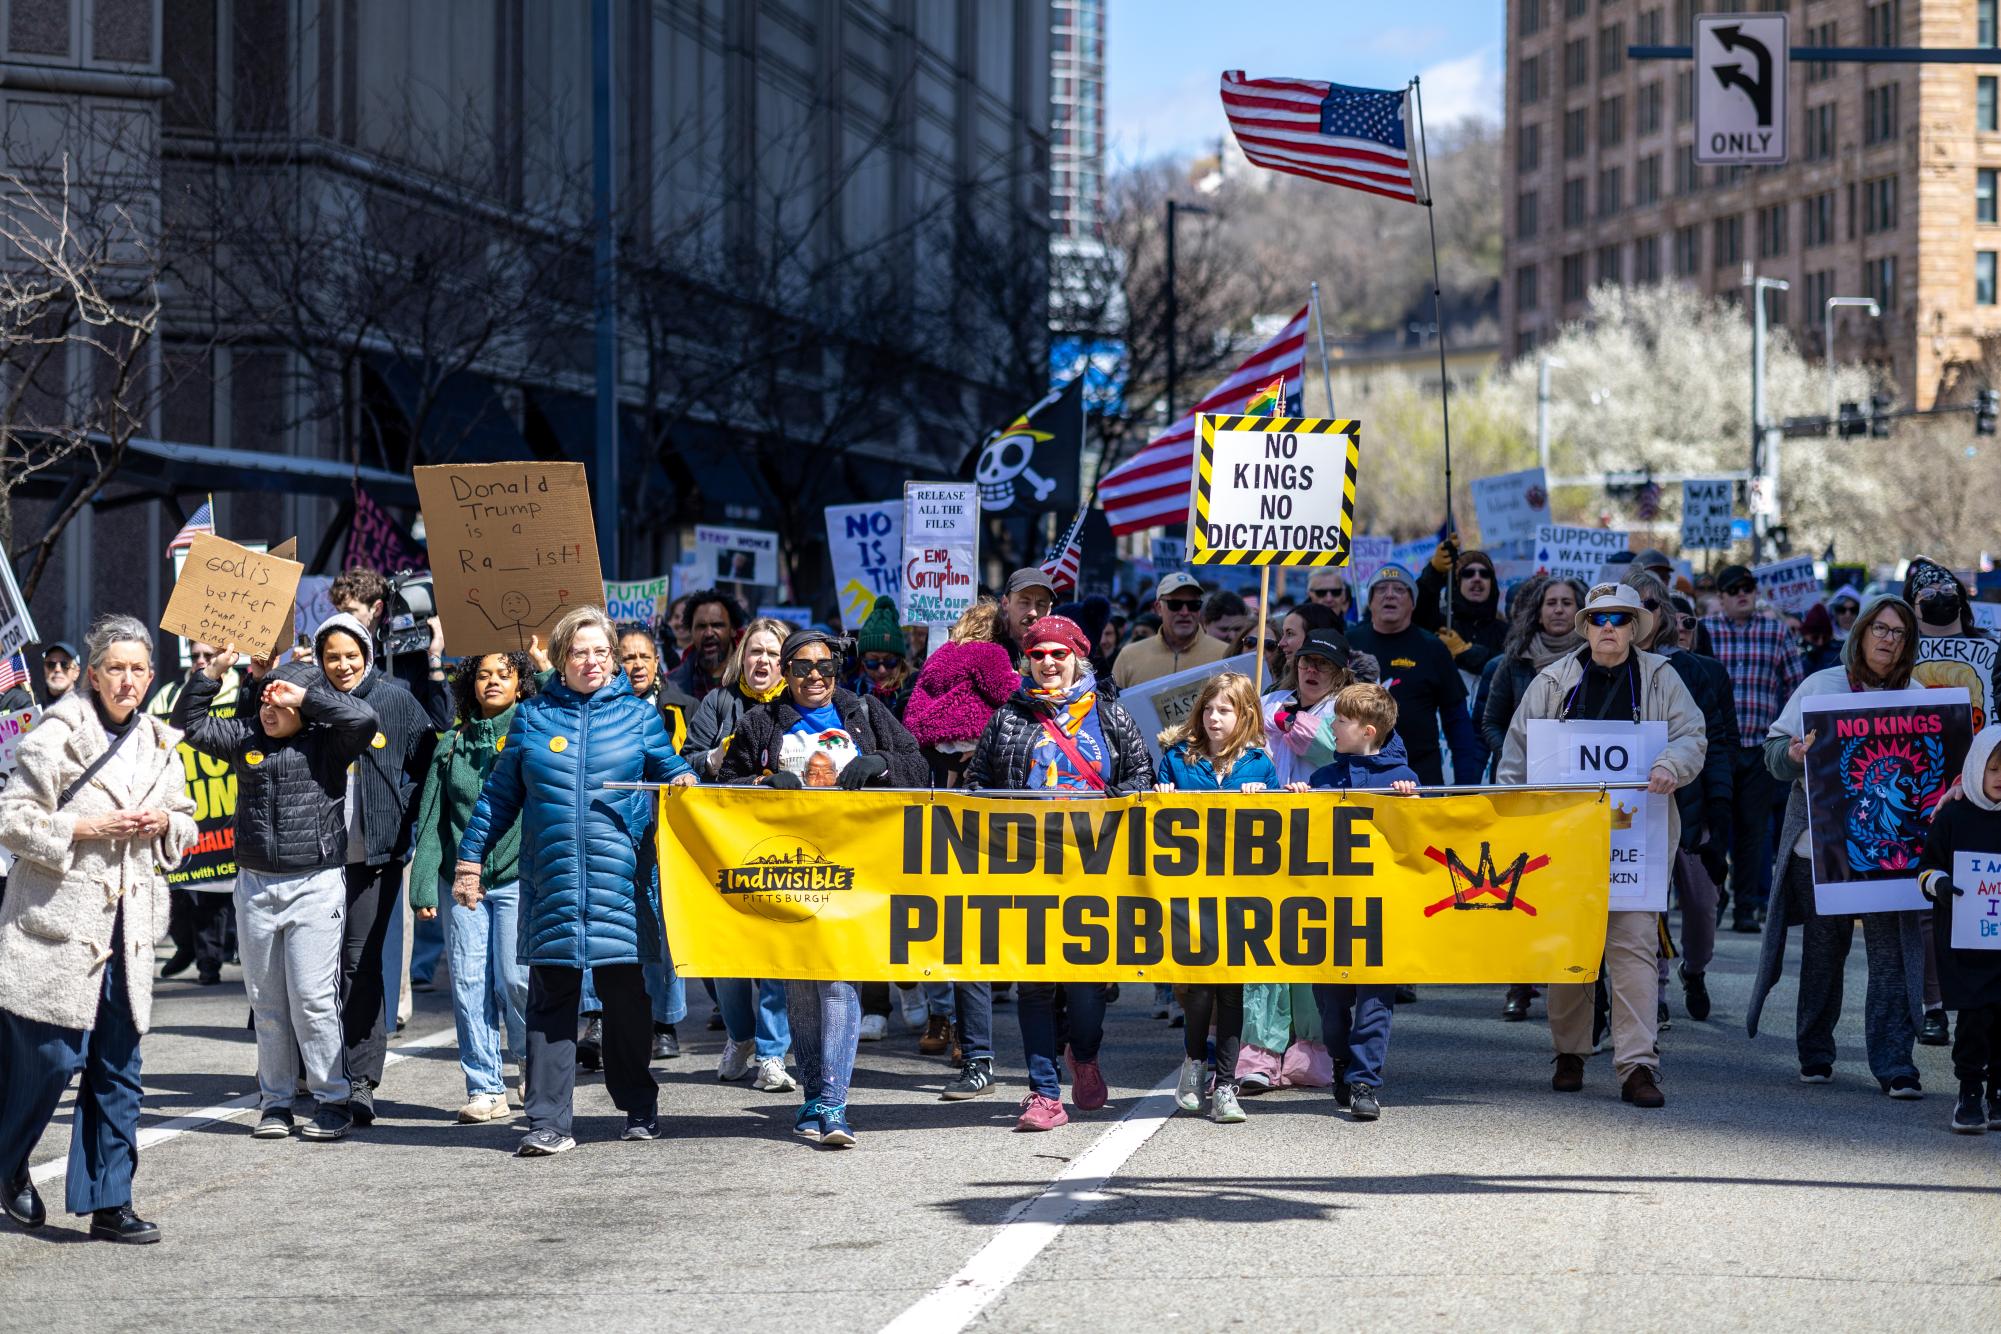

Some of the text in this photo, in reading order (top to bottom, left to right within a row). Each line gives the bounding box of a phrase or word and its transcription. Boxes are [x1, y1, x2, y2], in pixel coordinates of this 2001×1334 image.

[1711, 132, 1772, 154] ONLY
[1265, 433, 1298, 459] NO
[450, 475, 549, 501] Donald
[1233, 463, 1315, 491] KINGS
[917, 490, 966, 501] RELEASE
[1687, 484, 1728, 501] WAR
[917, 505, 964, 515] ALL THE
[1260, 494, 1293, 520] NO
[465, 523, 522, 539] is a
[845, 511, 892, 539] NO
[925, 519, 956, 529] FILES
[1207, 523, 1340, 550] DICTATORS
[1539, 526, 1628, 549] SUPPORT
[858, 540, 887, 568] IS
[924, 549, 948, 564] END
[866, 565, 902, 594] TH
[1551, 566, 1595, 583] FIRST
[606, 579, 667, 601] FUTURE
[909, 593, 969, 609] SAVE OUR
[606, 597, 655, 619] ONGS
[907, 607, 965, 622] DEMOCRAC
[1836, 713, 1944, 738] NO KINGS
[1092, 742, 1103, 761] 1776
[1580, 744, 1629, 772] NO
[902, 804, 1375, 877] INDIVISIBLE
[1609, 848, 1645, 864] PLE-
[1971, 859, 2001, 873] I A
[216, 861, 237, 876] ICE
[727, 866, 846, 890] Indivisible
[743, 893, 831, 904] PITTSBURGH
[1977, 880, 2001, 896] AN
[889, 894, 1384, 968] PITTSBURGH
[1980, 919, 2001, 938] BE
